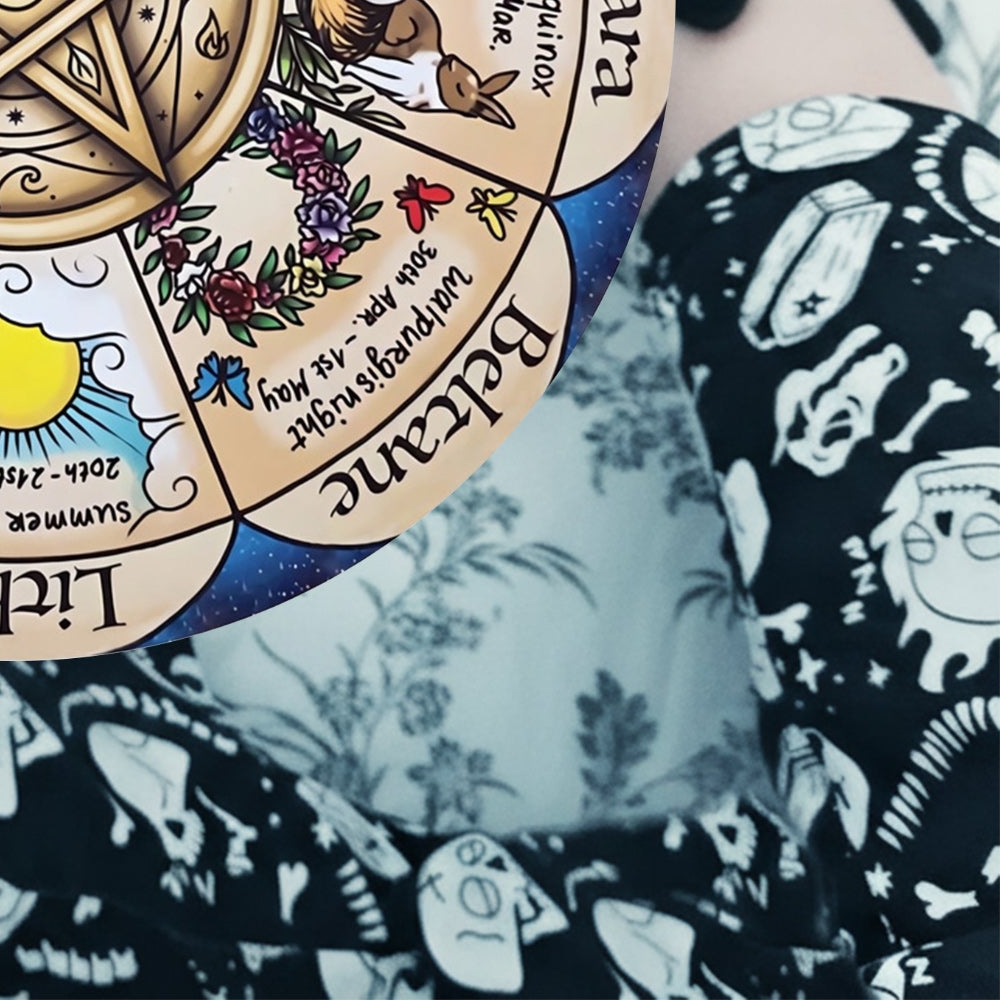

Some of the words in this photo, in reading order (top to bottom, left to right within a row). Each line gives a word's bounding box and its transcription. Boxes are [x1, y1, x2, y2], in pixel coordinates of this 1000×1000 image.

[395, 240, 438, 288] 30th
[311, 348, 345, 379] 1st
[257, 367, 306, 413] May
[318, 294, 558, 518] Beltane
